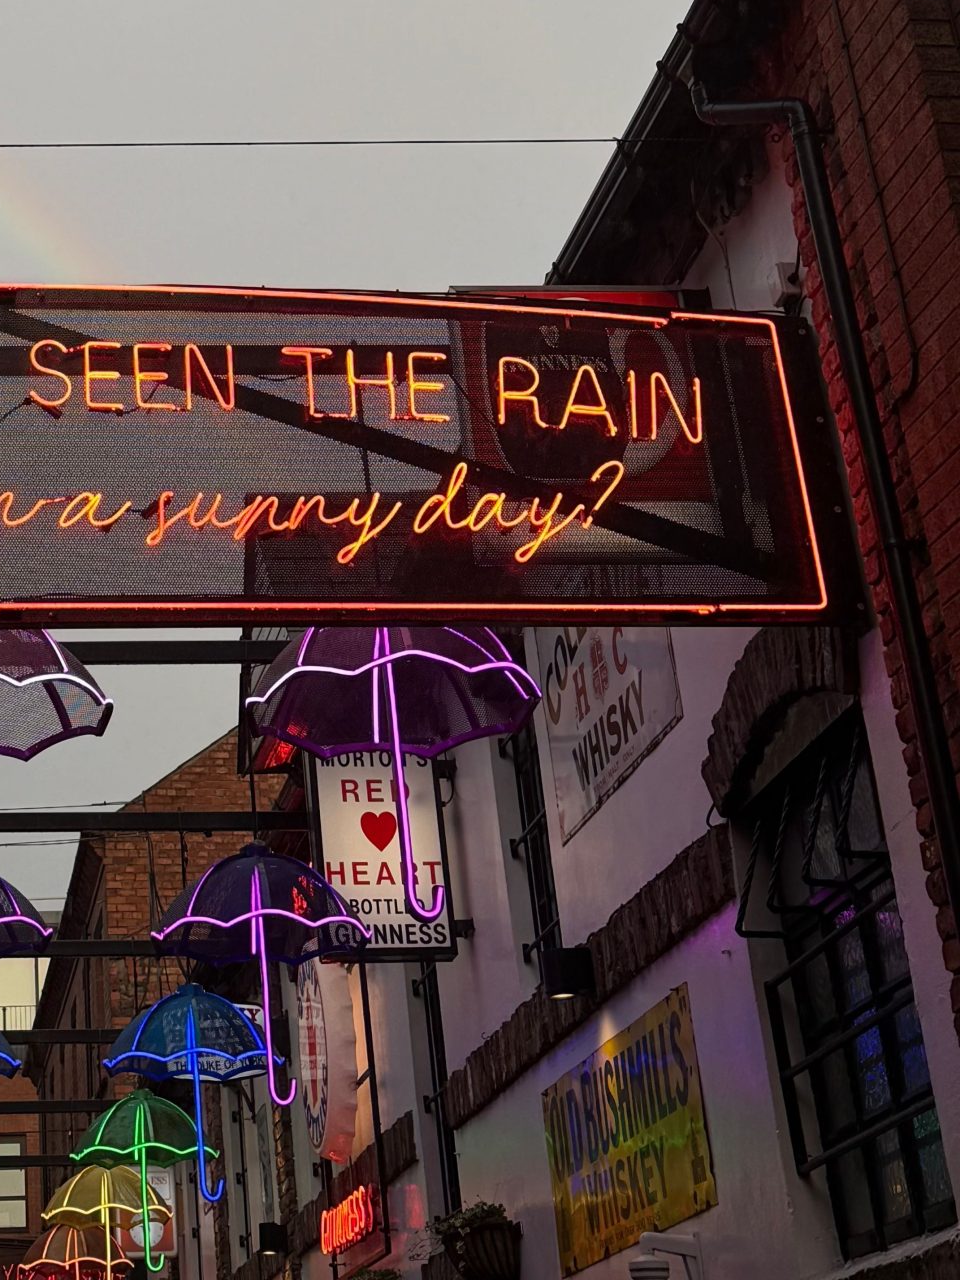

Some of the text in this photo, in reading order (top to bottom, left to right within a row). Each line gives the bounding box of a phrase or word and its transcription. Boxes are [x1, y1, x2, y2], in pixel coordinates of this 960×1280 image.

[28, 340, 237, 413] SEEN
[281, 347, 451, 422] THE
[498, 355, 704, 445] RAIN
[58, 490, 128, 530] a
[146, 490, 403, 564] sunny
[413, 460, 625, 564] day?
[320, 752, 428, 768] MORTO'S
[571, 668, 645, 793] WHISKY
[326, 862, 441, 885] HEART
[334, 923, 447, 945] GUINNESS
[583, 1135, 668, 1236] WHISKEY
